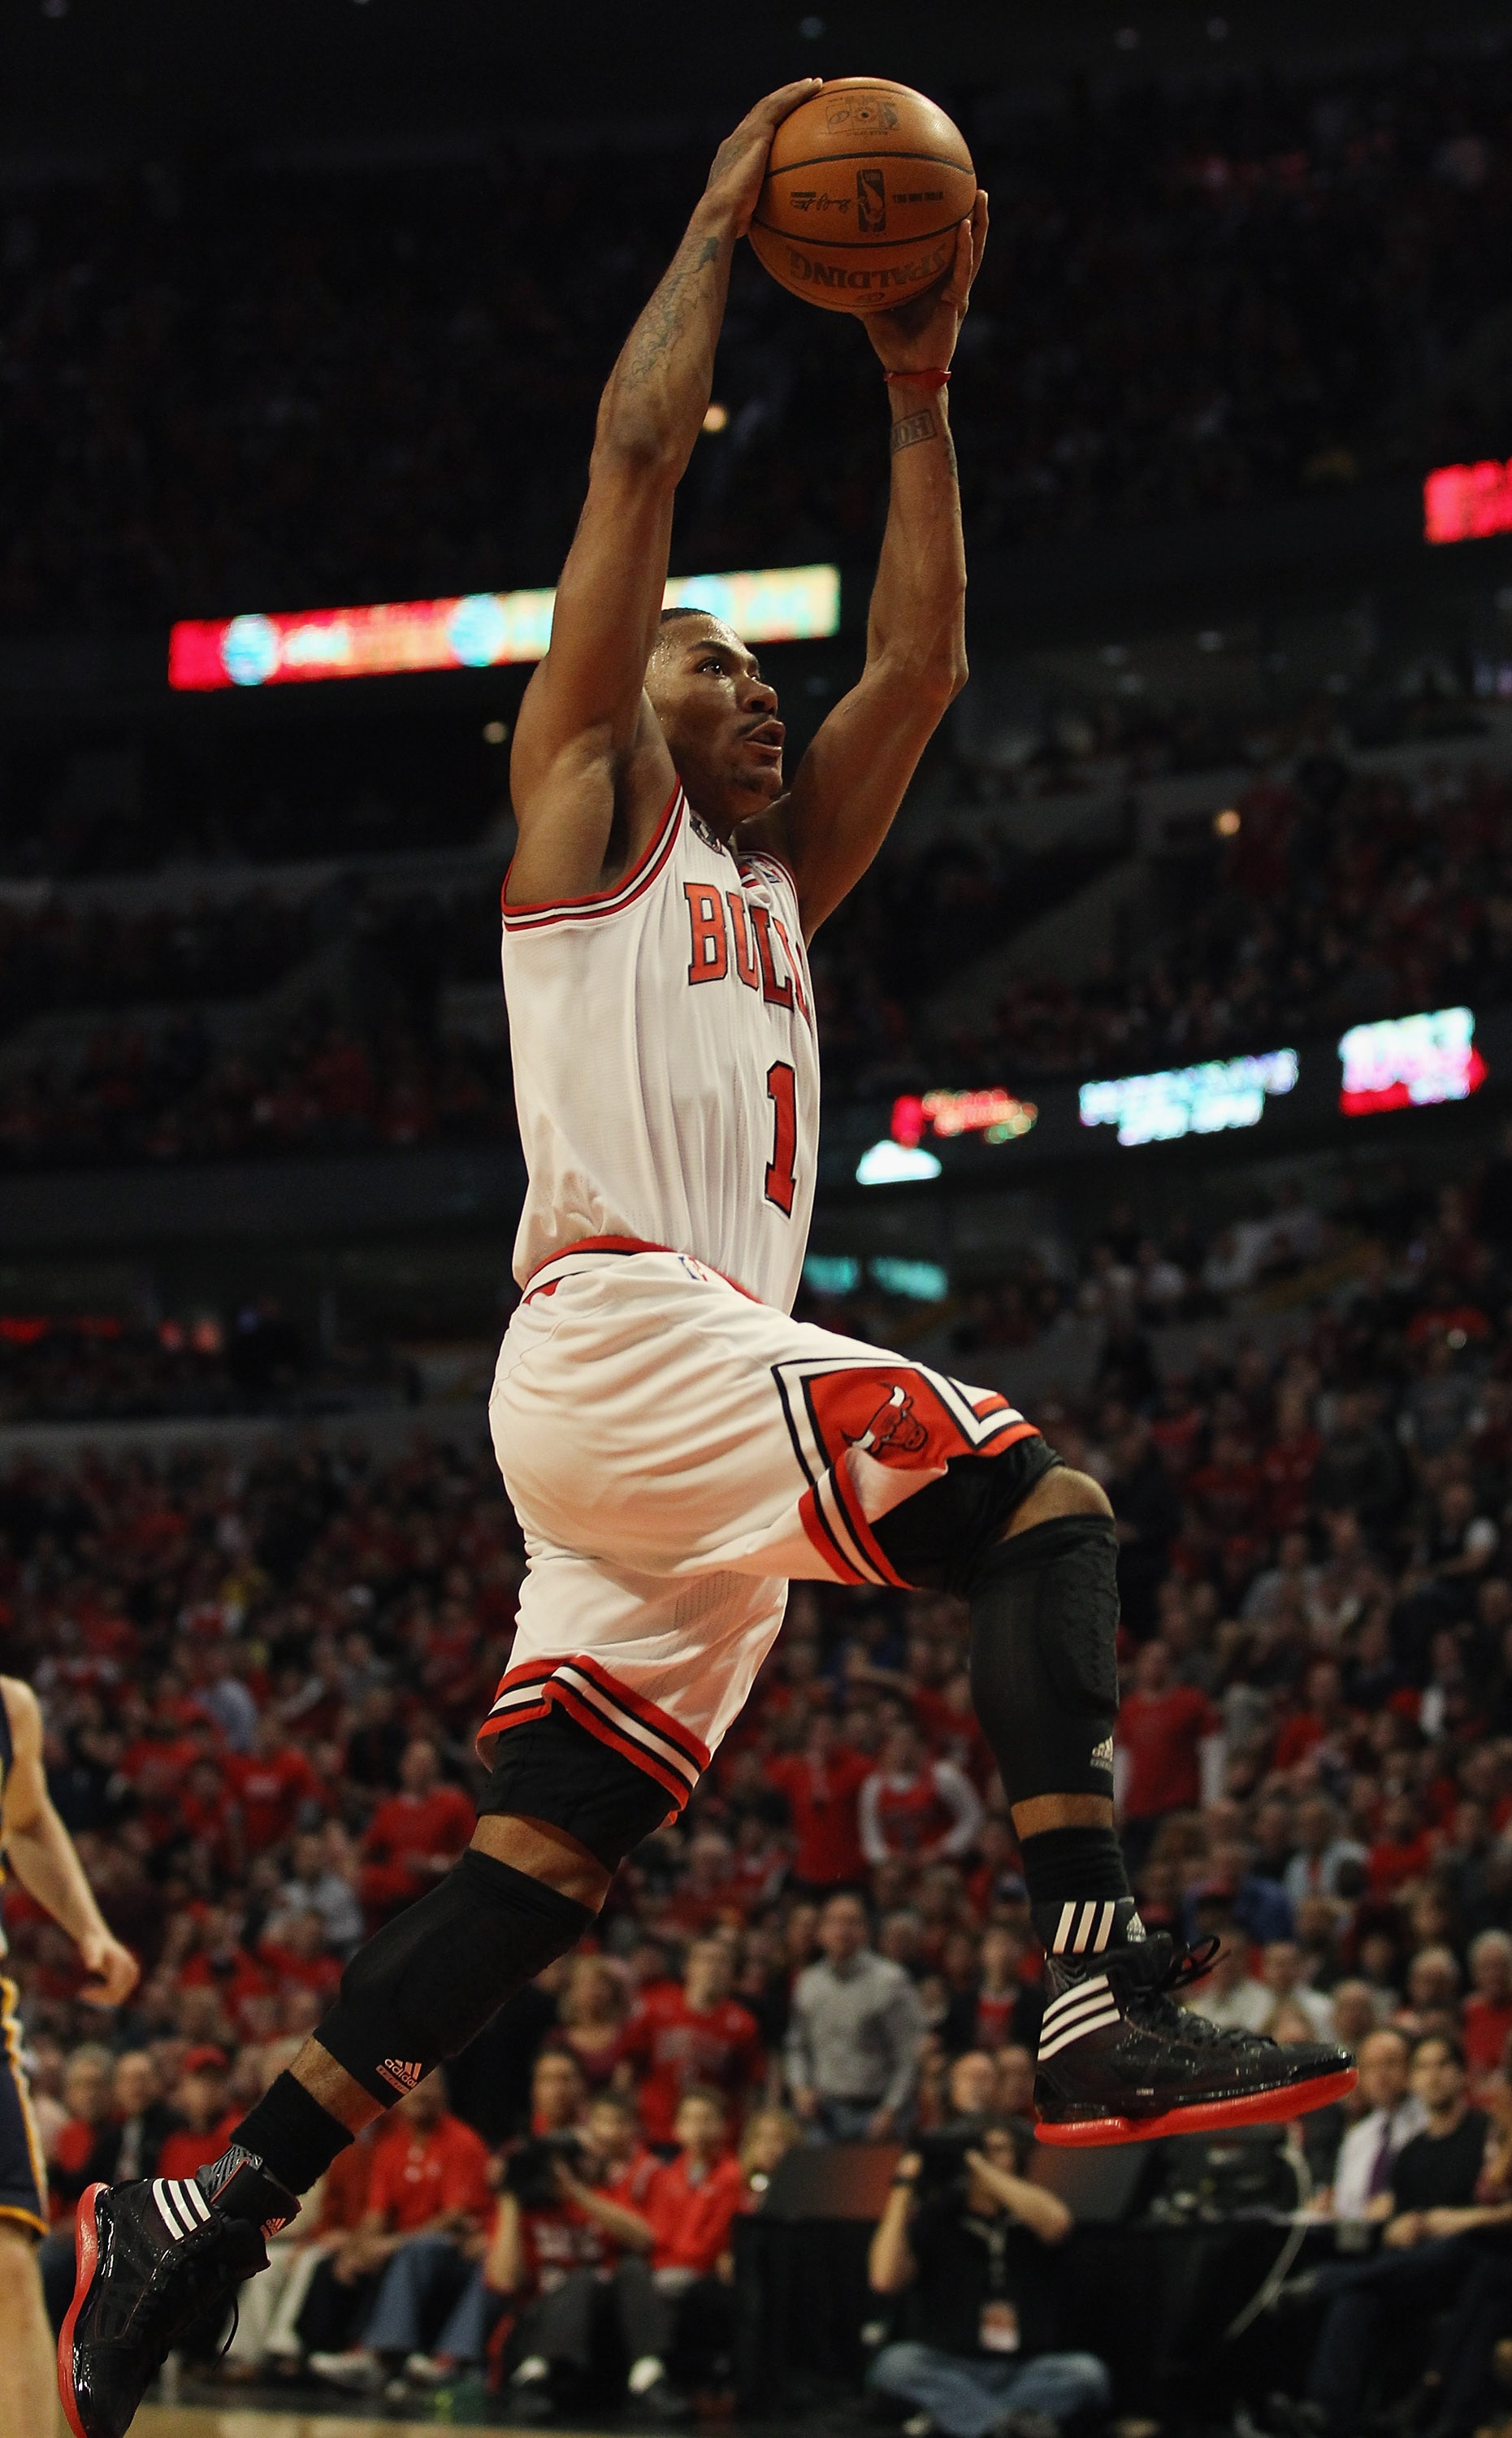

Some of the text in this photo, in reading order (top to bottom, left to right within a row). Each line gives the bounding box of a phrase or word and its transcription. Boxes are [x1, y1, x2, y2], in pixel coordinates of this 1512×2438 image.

[786, 245, 947, 289] SPALDING
[683, 882, 812, 1027] BULL
[765, 1060, 796, 1218] 1
